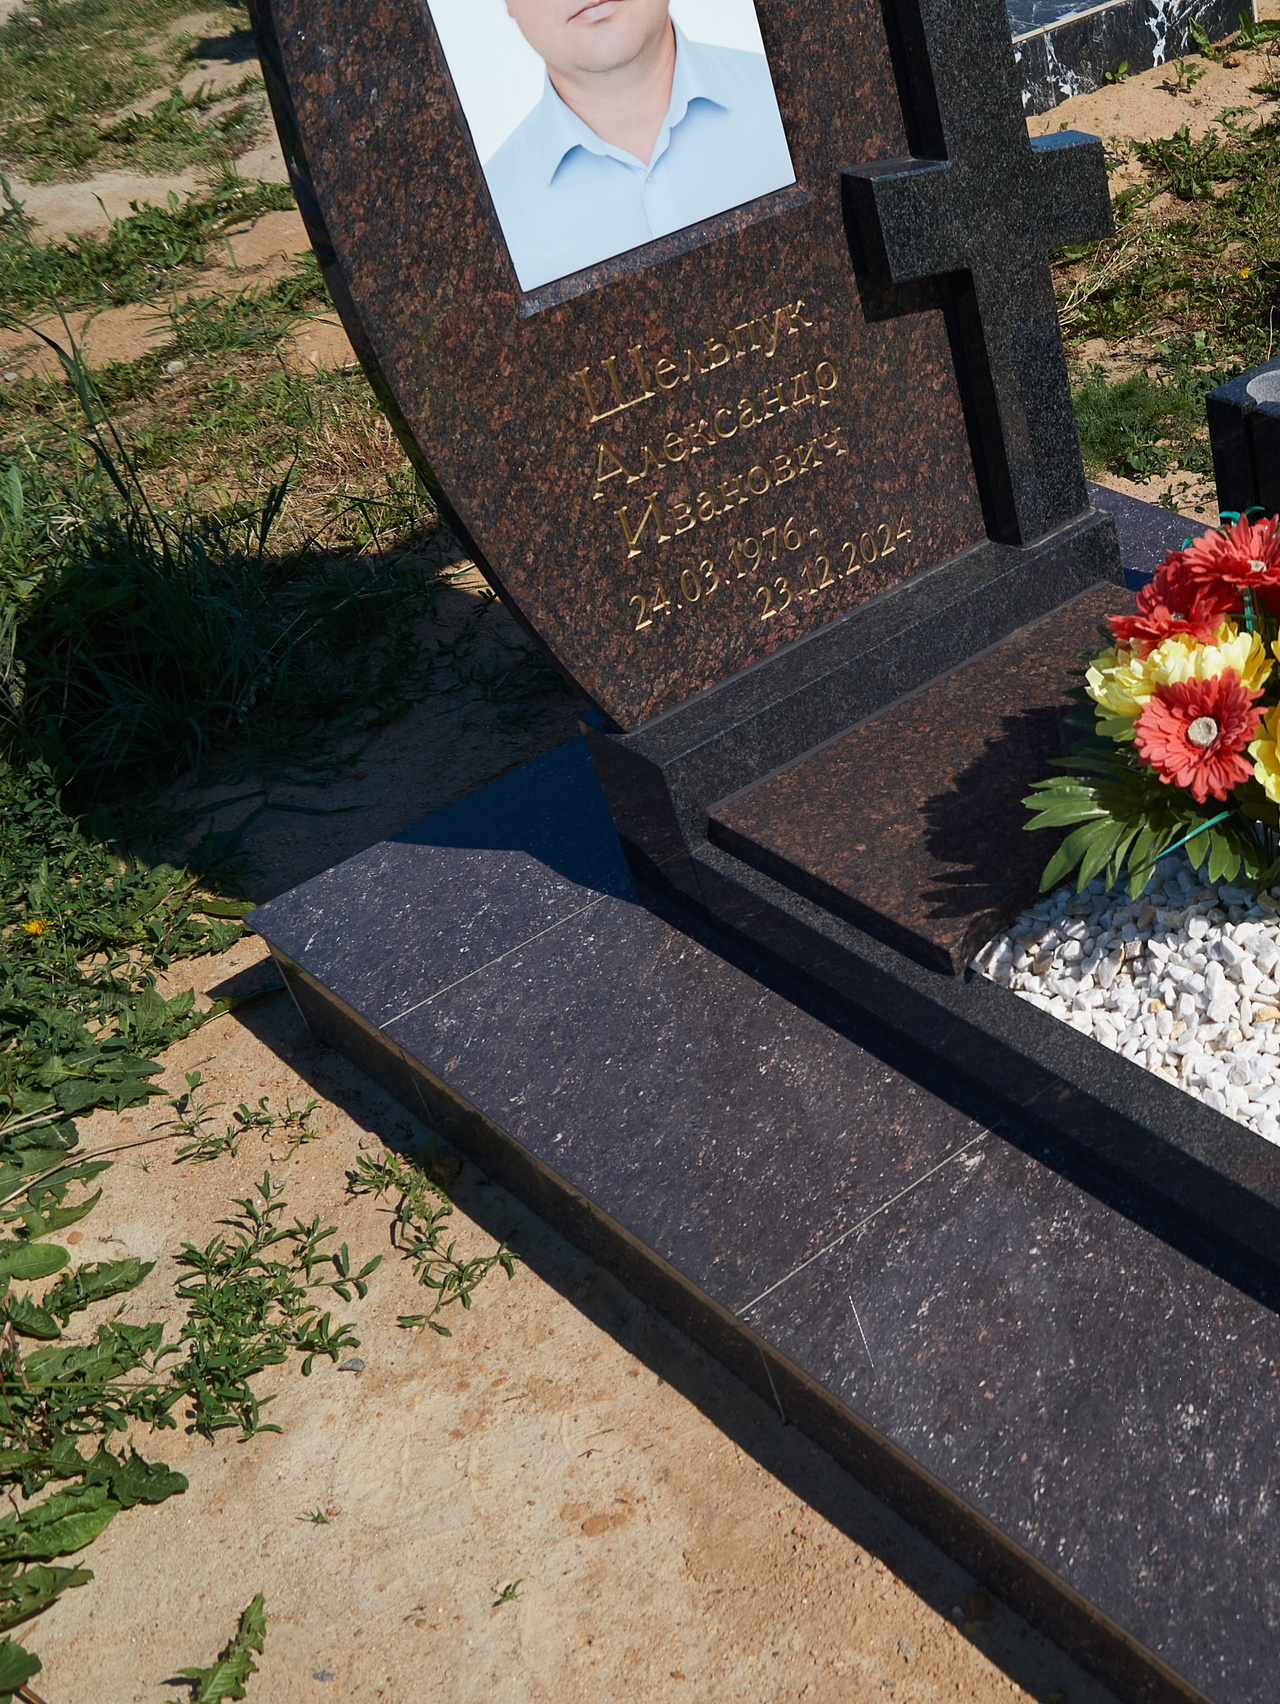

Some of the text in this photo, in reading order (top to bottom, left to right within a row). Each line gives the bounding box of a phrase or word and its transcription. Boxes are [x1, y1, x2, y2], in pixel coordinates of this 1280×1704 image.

[575, 300, 814, 423] Шельпук
[593, 360, 839, 500] Александр
[614, 427, 847, 559] Иванович
[756, 515, 912, 621] 23.12.2024
